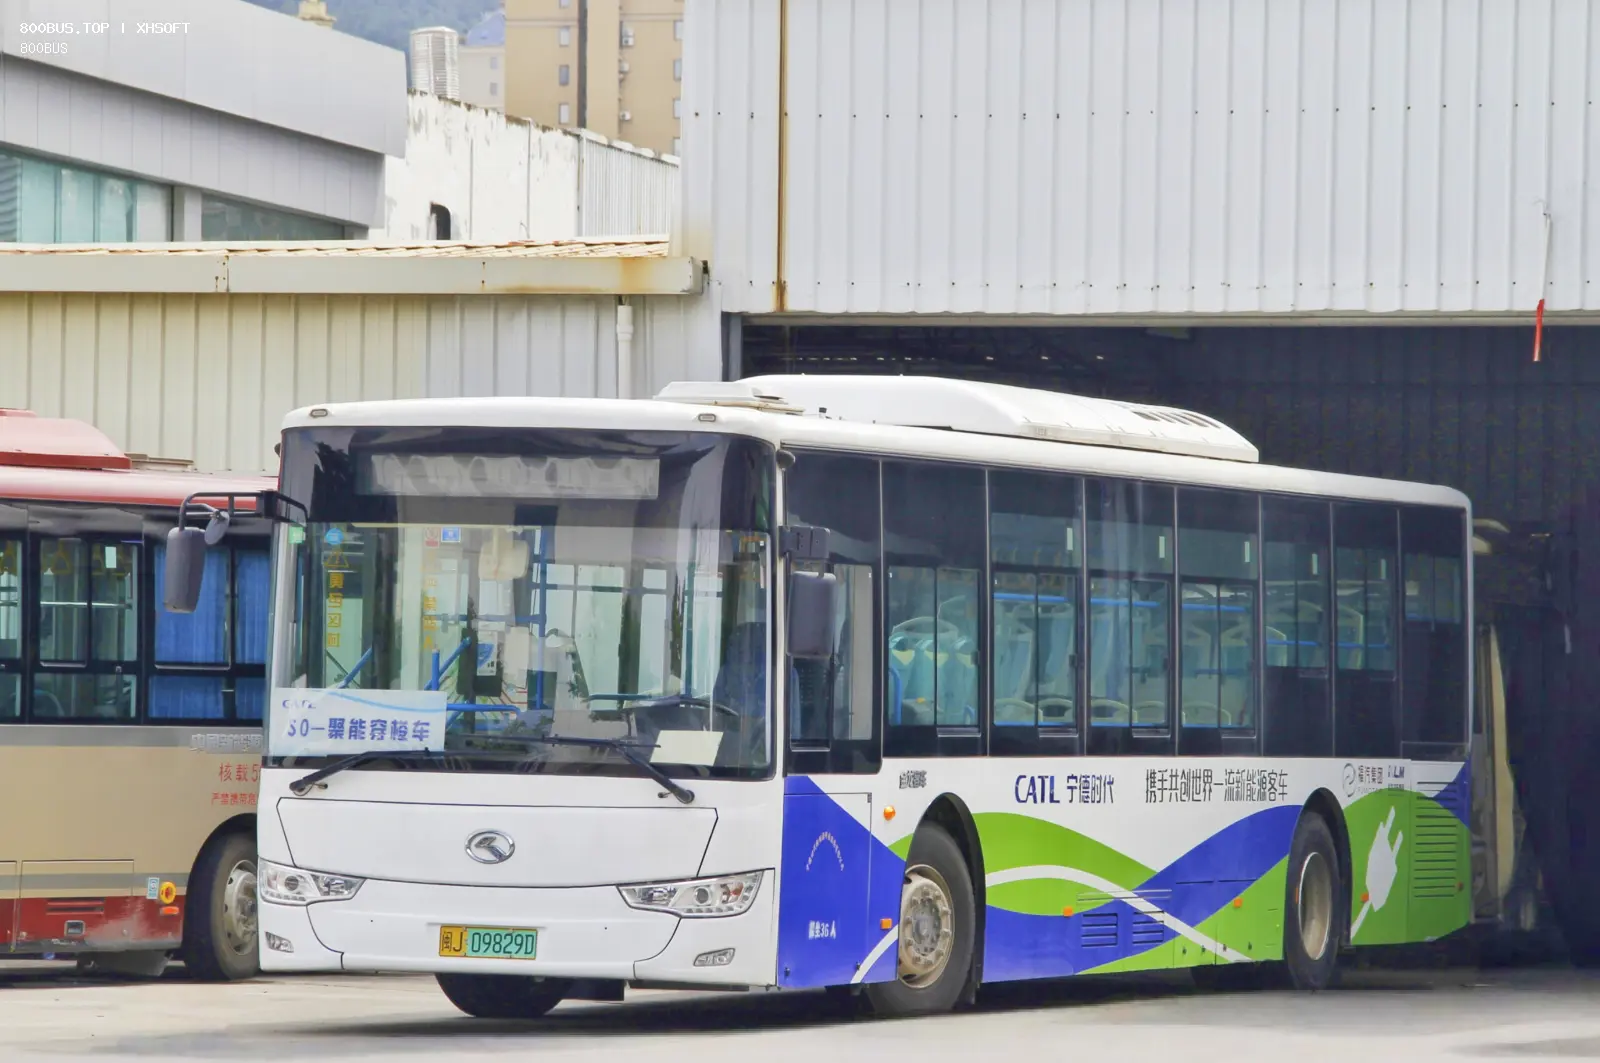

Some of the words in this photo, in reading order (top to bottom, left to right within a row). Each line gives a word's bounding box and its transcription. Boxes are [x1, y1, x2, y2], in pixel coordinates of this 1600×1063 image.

[219, 762, 261, 783] 核载5
[1145, 768, 1288, 803] 携手共创世界一流新能源客车
[1014, 774, 1060, 804] CATL
[1066, 773, 1114, 804] 宁德时代
[441, 930, 464, 953] 闽J
[471, 932, 535, 955] 09829D
